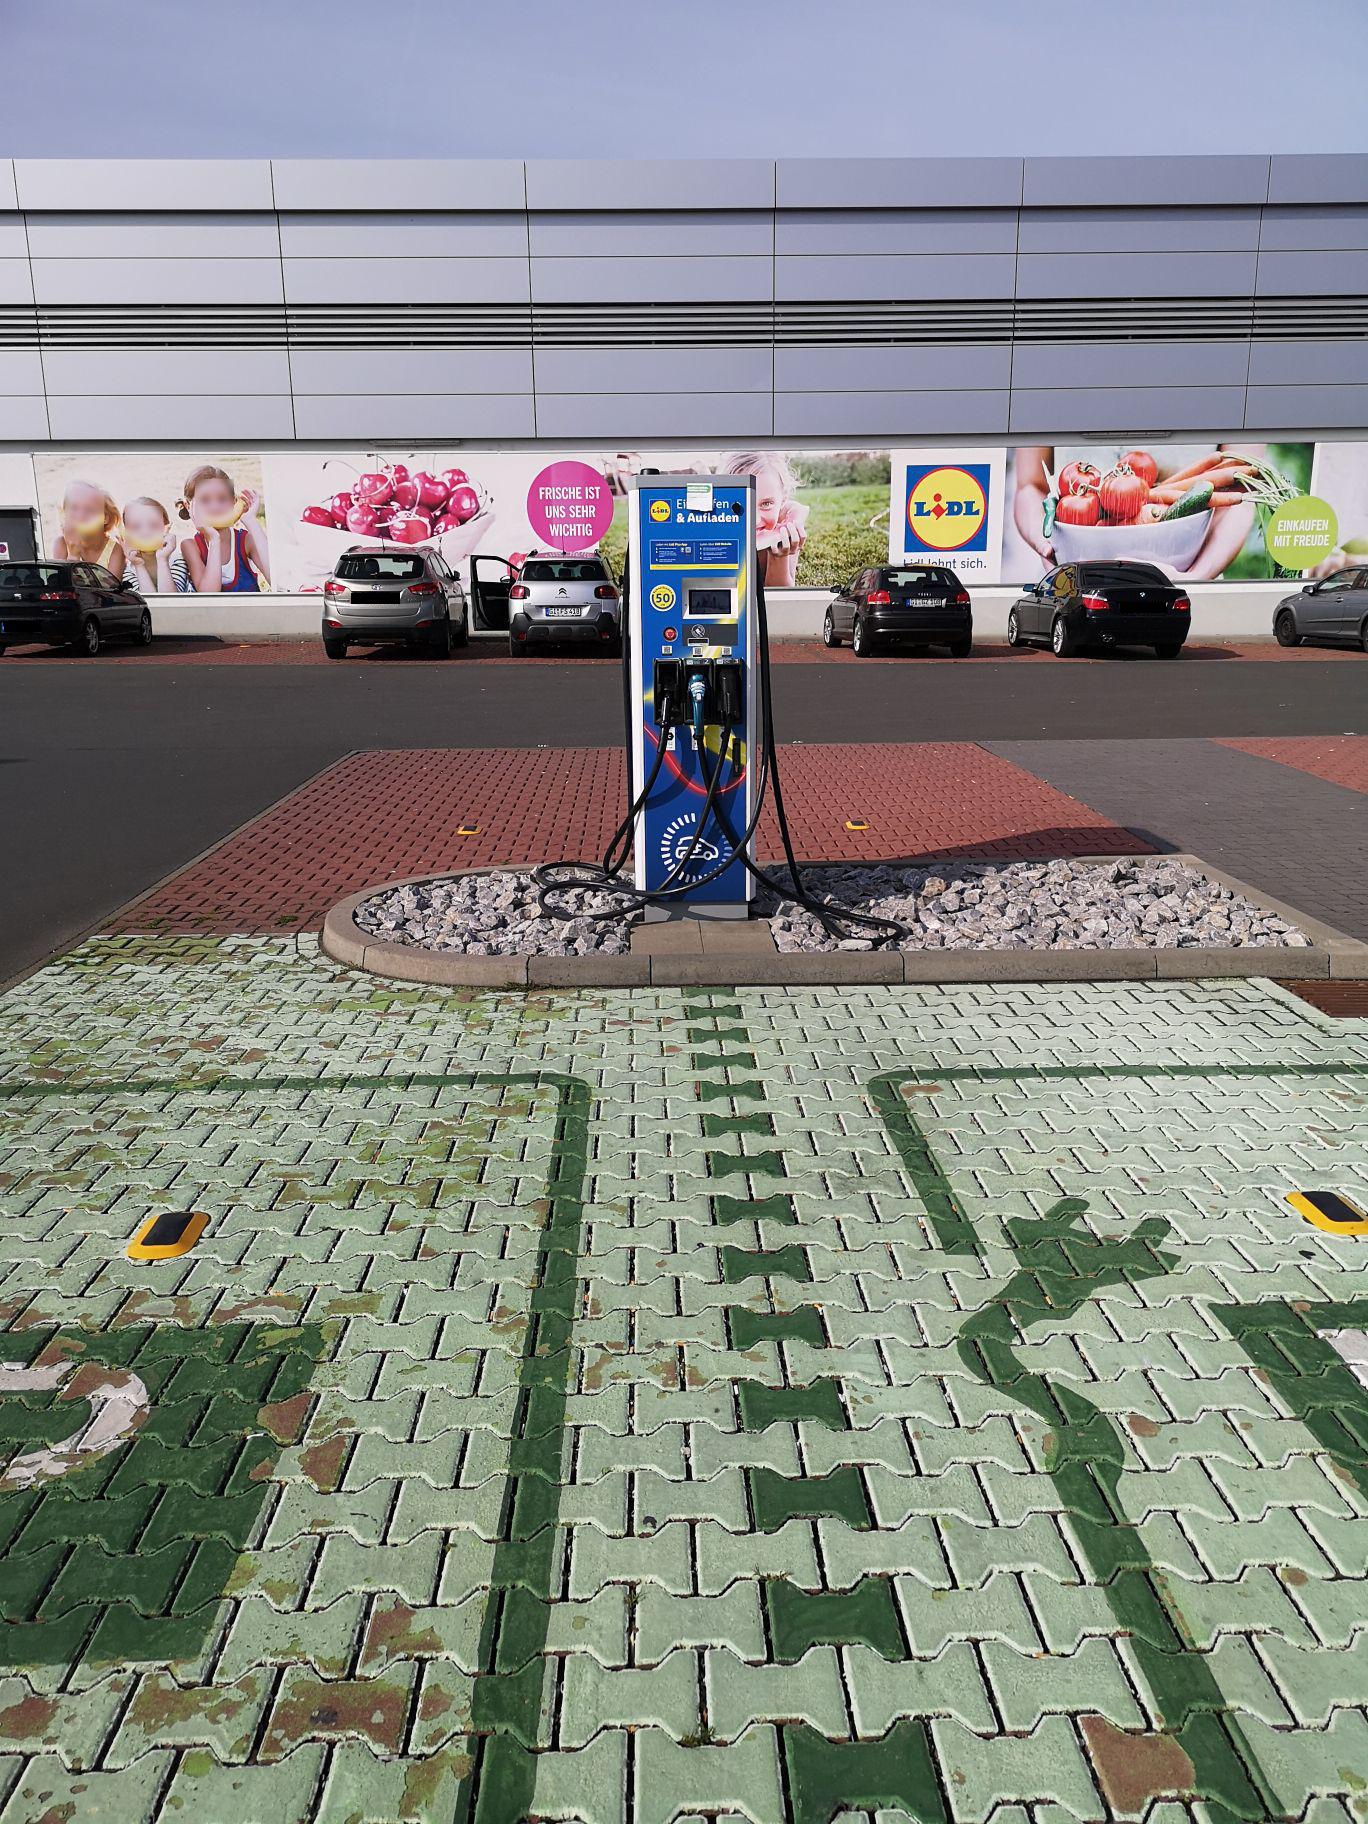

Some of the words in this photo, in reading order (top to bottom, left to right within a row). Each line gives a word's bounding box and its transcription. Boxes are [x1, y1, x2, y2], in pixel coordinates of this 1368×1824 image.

[539, 486, 583, 500] FRISCHE
[585, 486, 601, 500] IST
[545, 505, 566, 518] UNS
[569, 505, 596, 518] SEHR
[676, 513, 685, 523] &
[687, 512, 739, 523] Aufladen
[549, 523, 593, 537] WICHTIG
[1277, 519, 1329, 532] EINKAUFEN
[1274, 535, 1291, 547] MIT
[1293, 534, 1330, 547] FREUDE
[960, 557, 987, 569] sich.
[656, 593, 670, 603] 50
